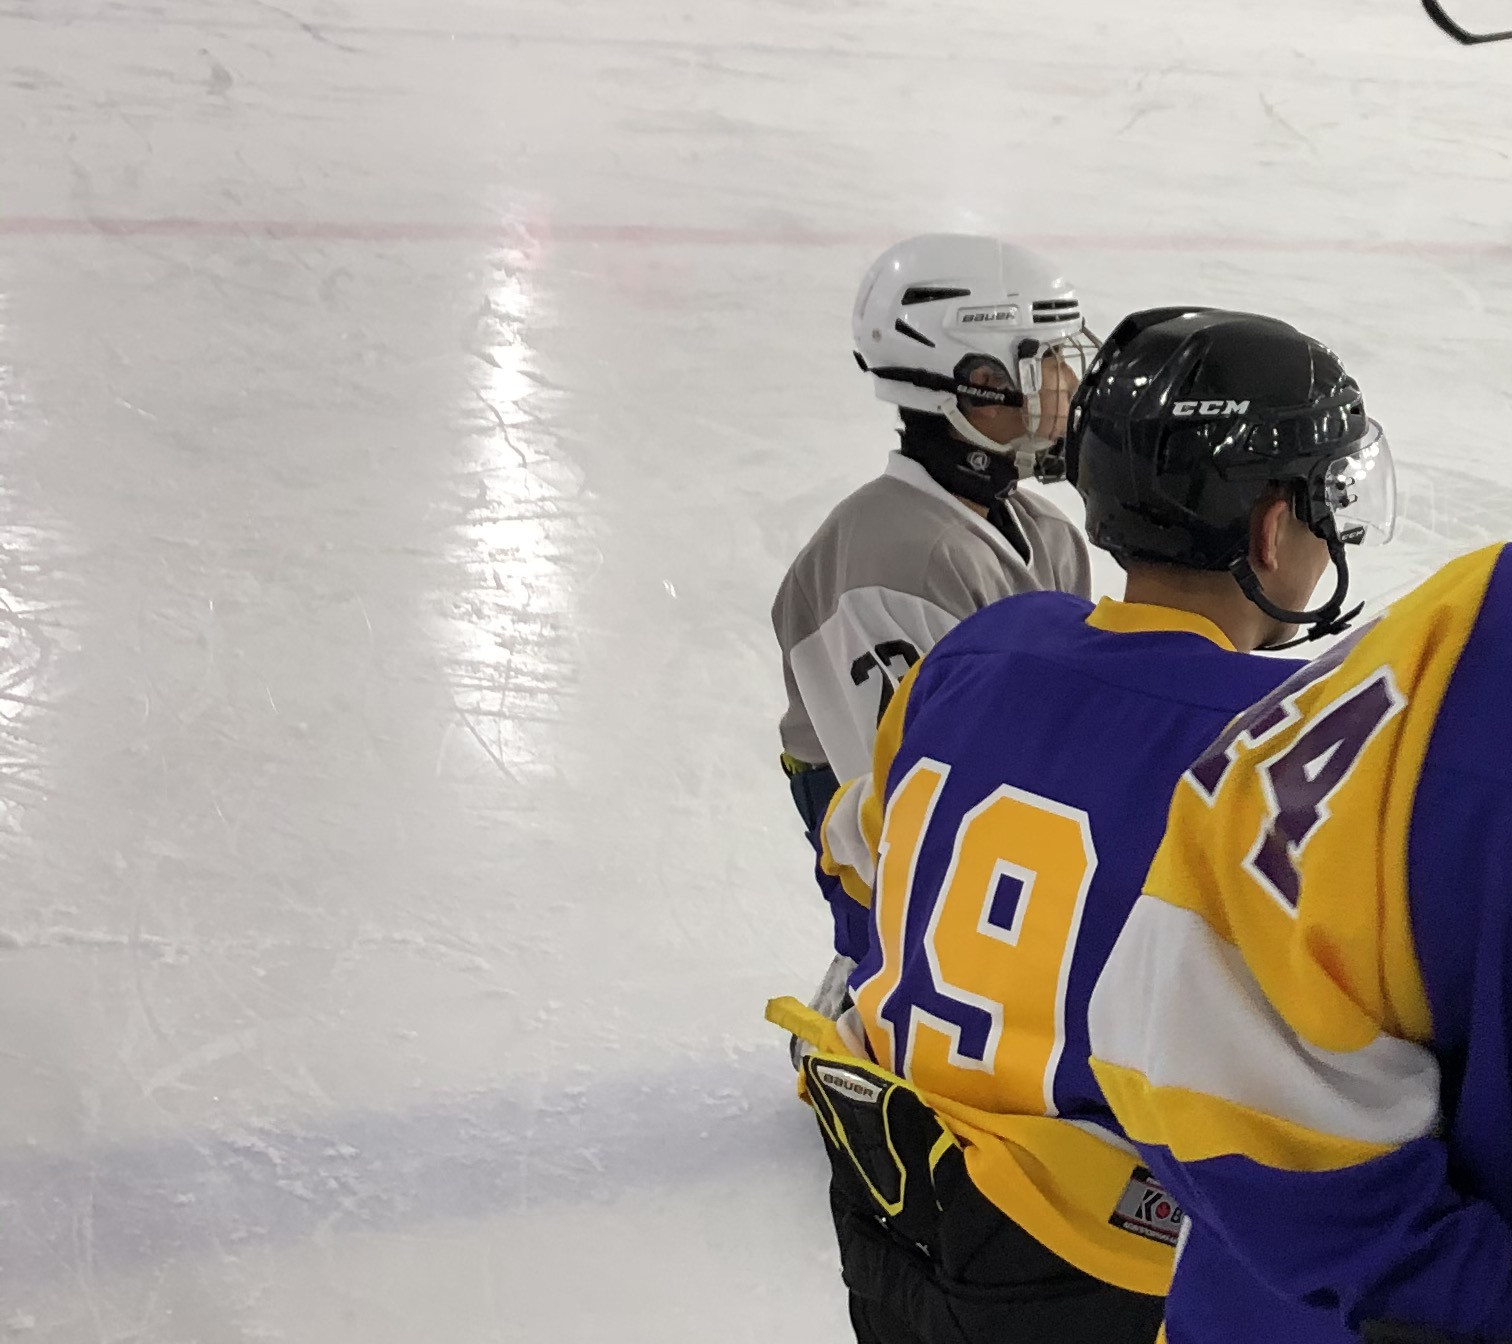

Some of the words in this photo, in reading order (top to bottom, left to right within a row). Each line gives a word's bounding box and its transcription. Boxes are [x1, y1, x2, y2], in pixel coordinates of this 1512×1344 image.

[1172, 400, 1250, 416] CCM
[858, 756, 1099, 1117] 19
[823, 1073, 874, 1100] BAUER
